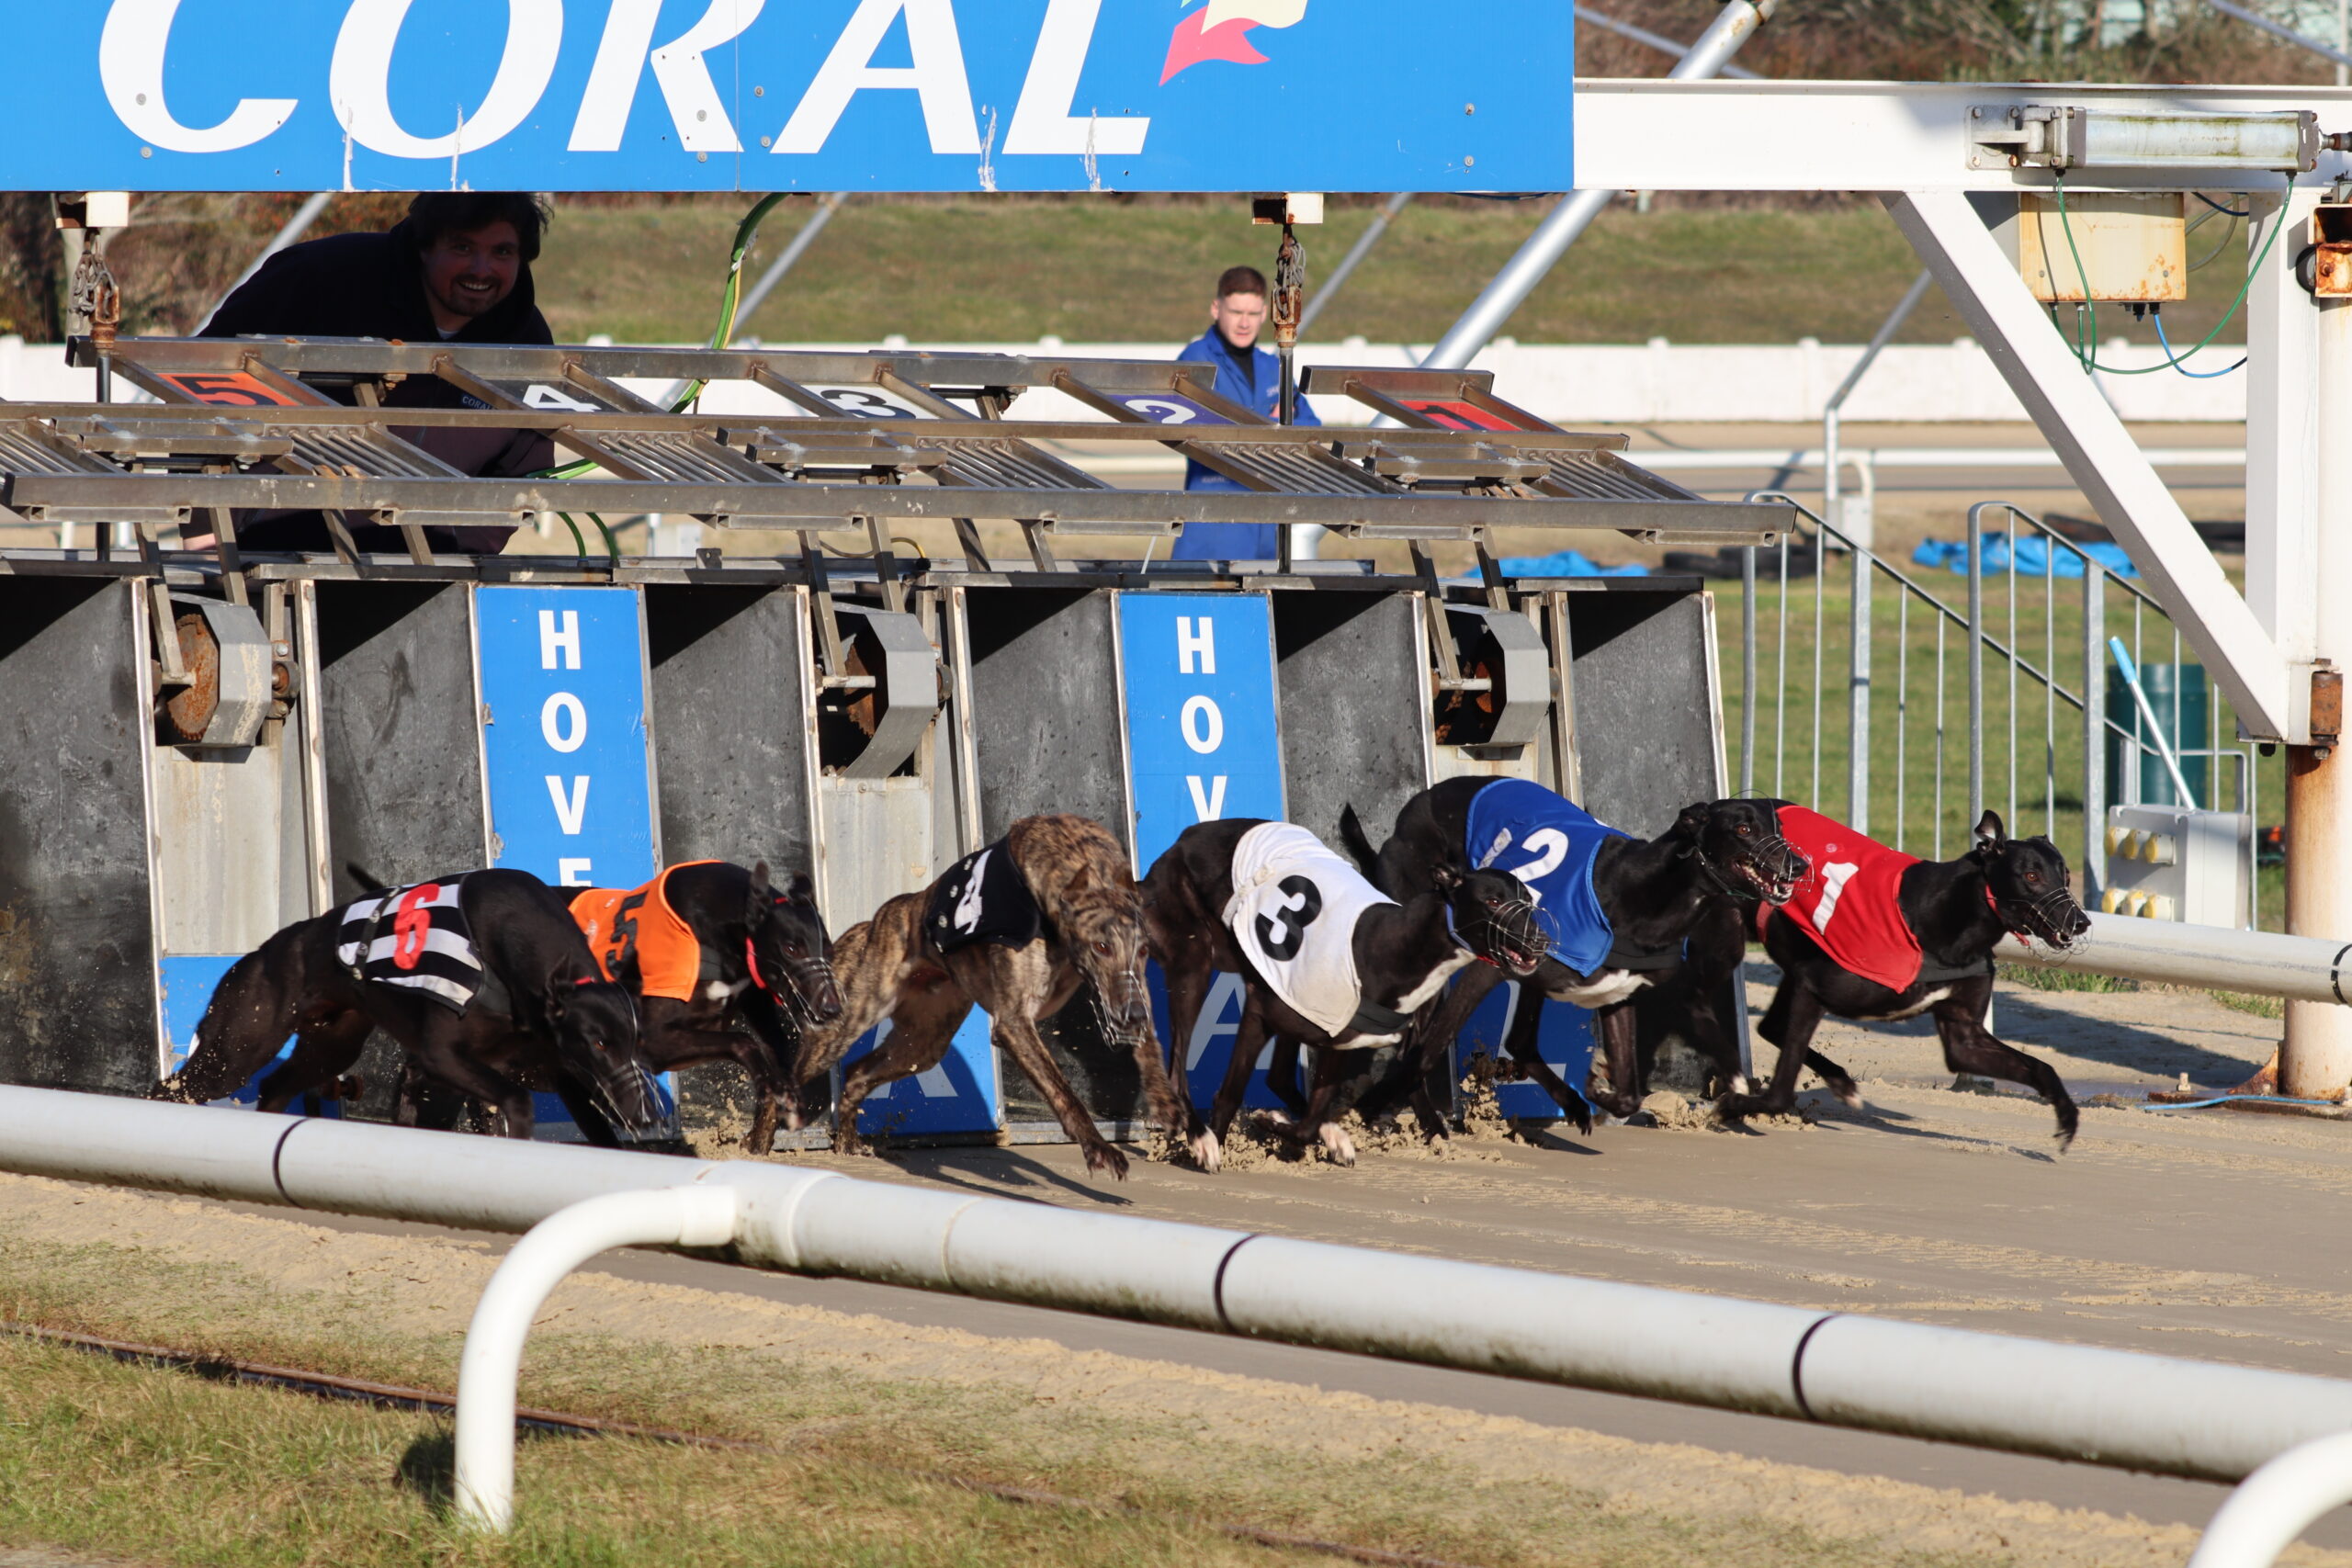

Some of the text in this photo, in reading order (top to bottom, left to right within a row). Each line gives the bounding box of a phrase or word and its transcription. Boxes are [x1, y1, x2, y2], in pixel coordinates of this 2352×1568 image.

[99, 0, 1150, 158] CORAL
[172, 377, 278, 405] 5
[523, 385, 602, 412] 4
[820, 389, 917, 419] 3
[1509, 828, 1569, 908] 2
[1812, 861, 1860, 936] 1
[393, 883, 441, 970] 6
[605, 889, 650, 977] 5
[1255, 874, 1323, 962] 3
